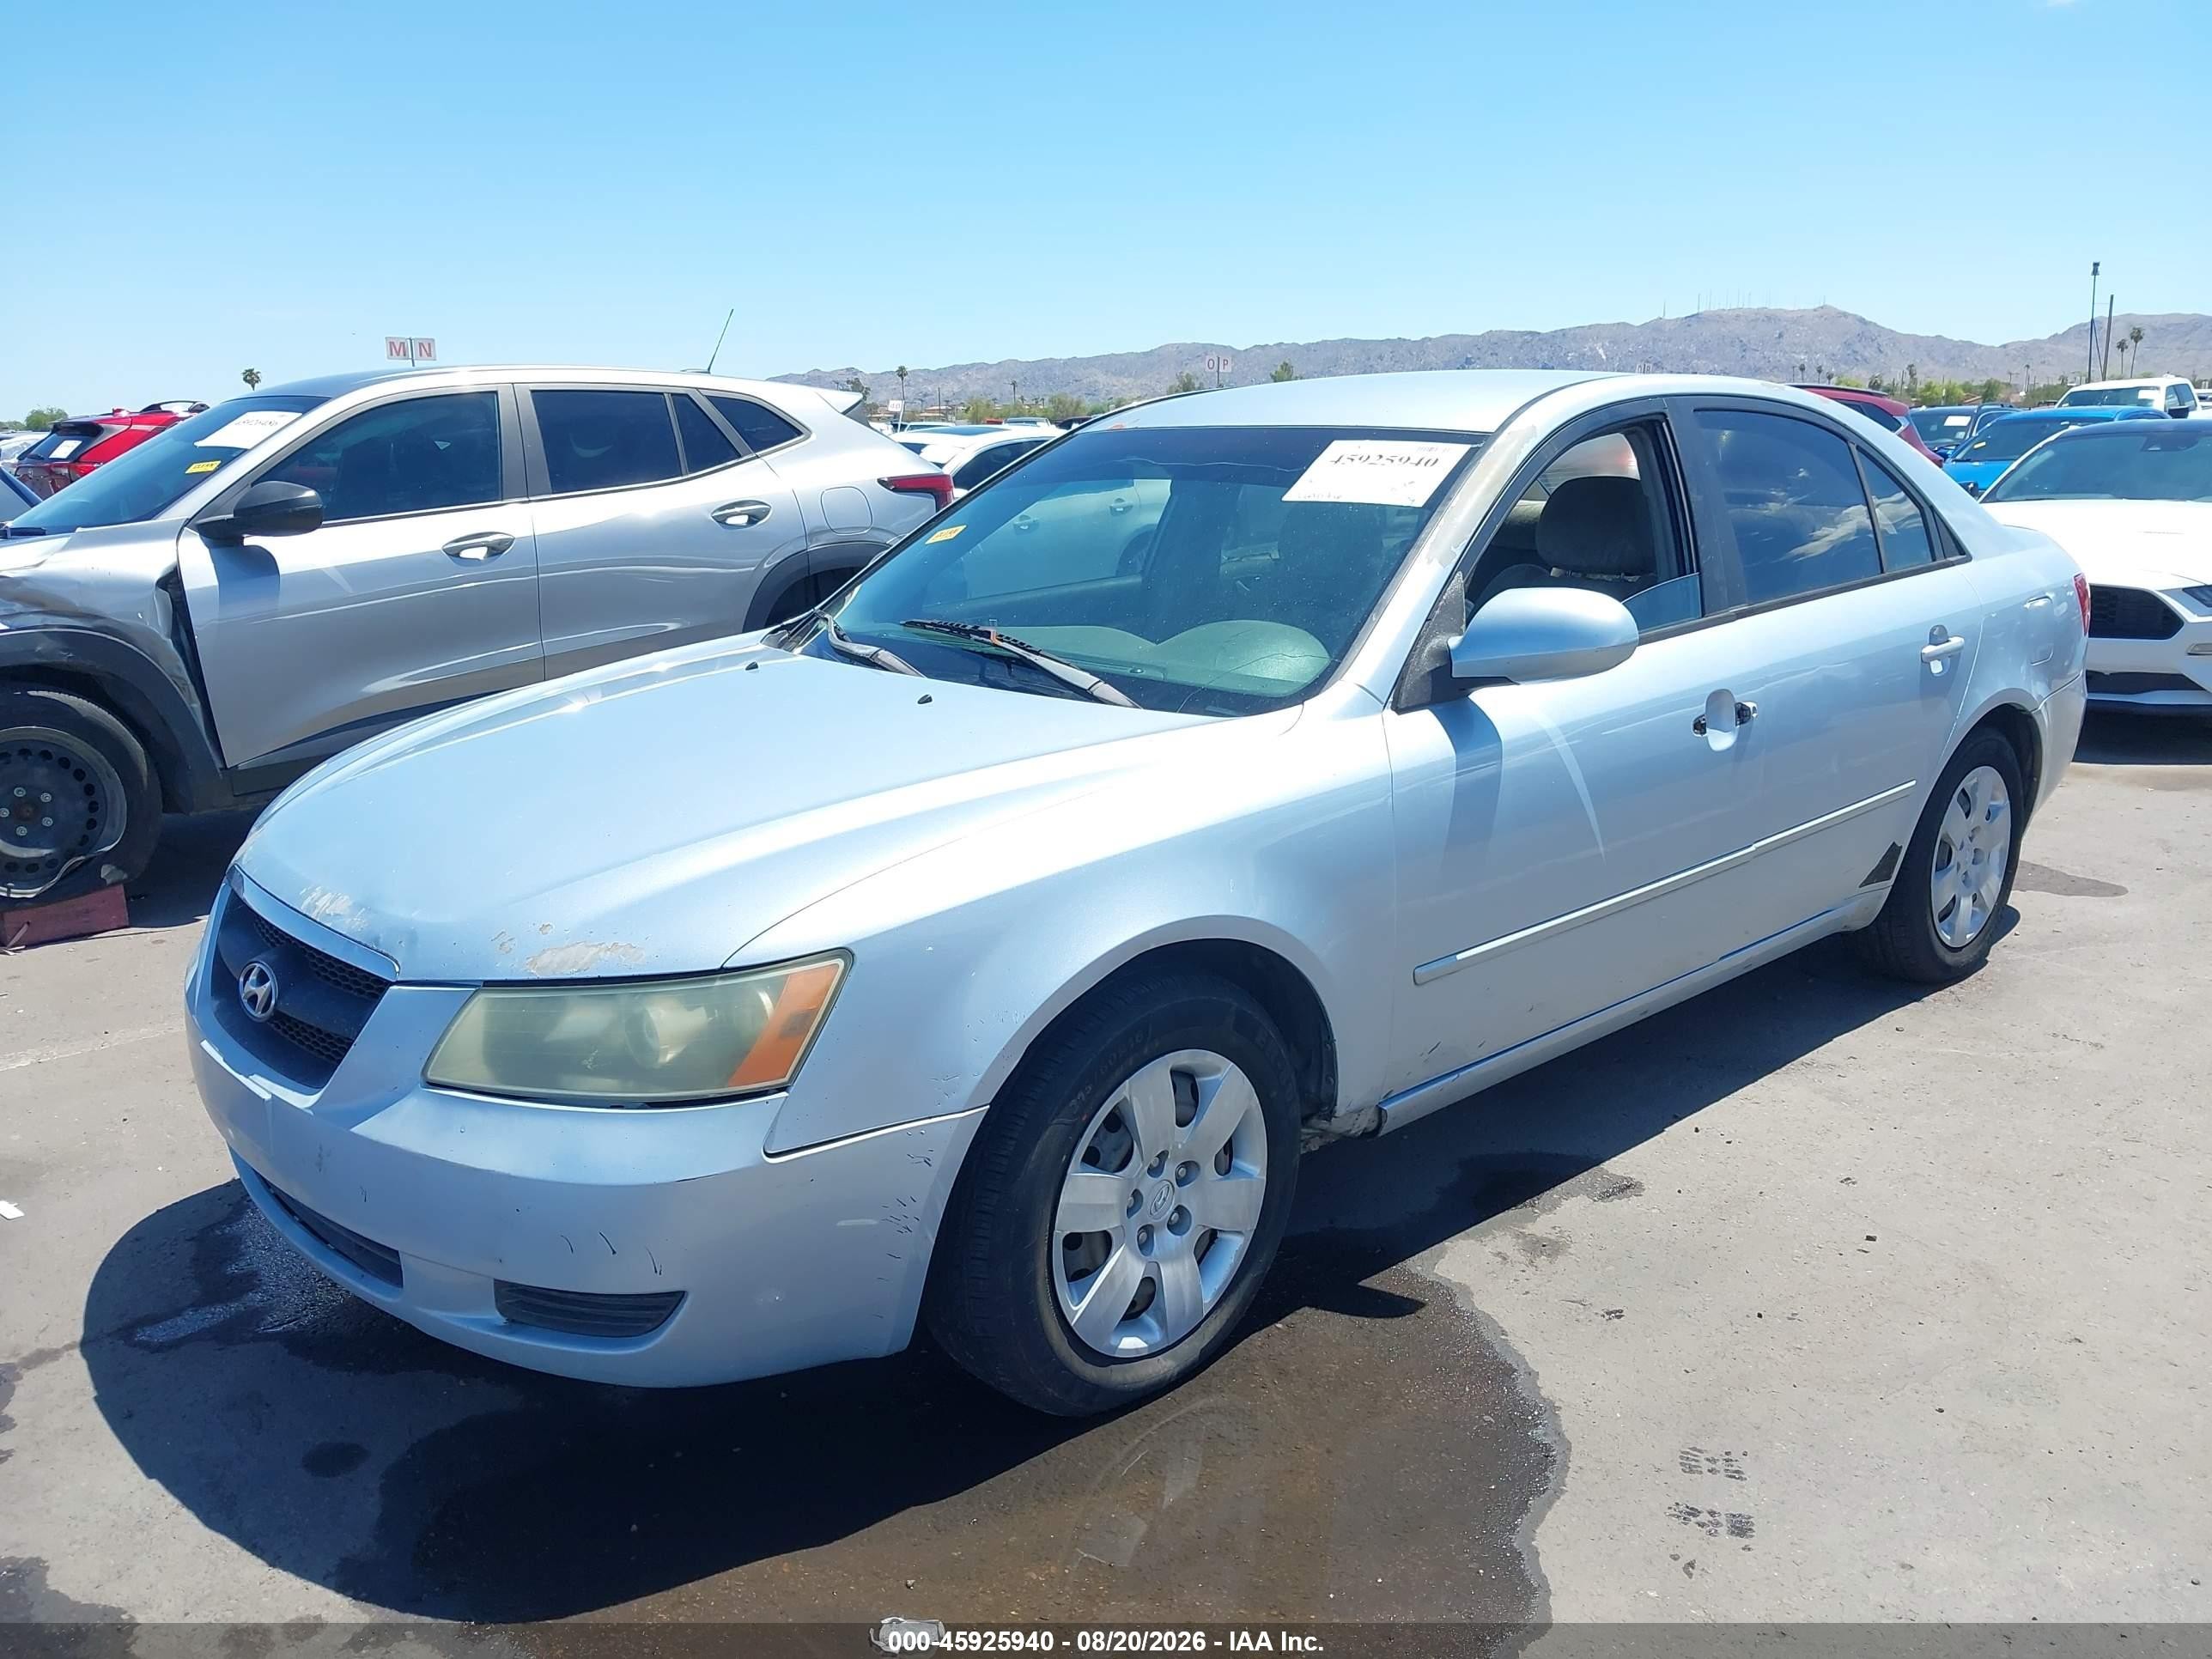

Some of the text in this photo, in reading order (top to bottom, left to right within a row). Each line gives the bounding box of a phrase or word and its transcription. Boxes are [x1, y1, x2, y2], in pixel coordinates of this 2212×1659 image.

[389, 341, 432, 357] M N
[1223, 358, 1229, 370] P
[1329, 454, 1439, 467] 45925940
